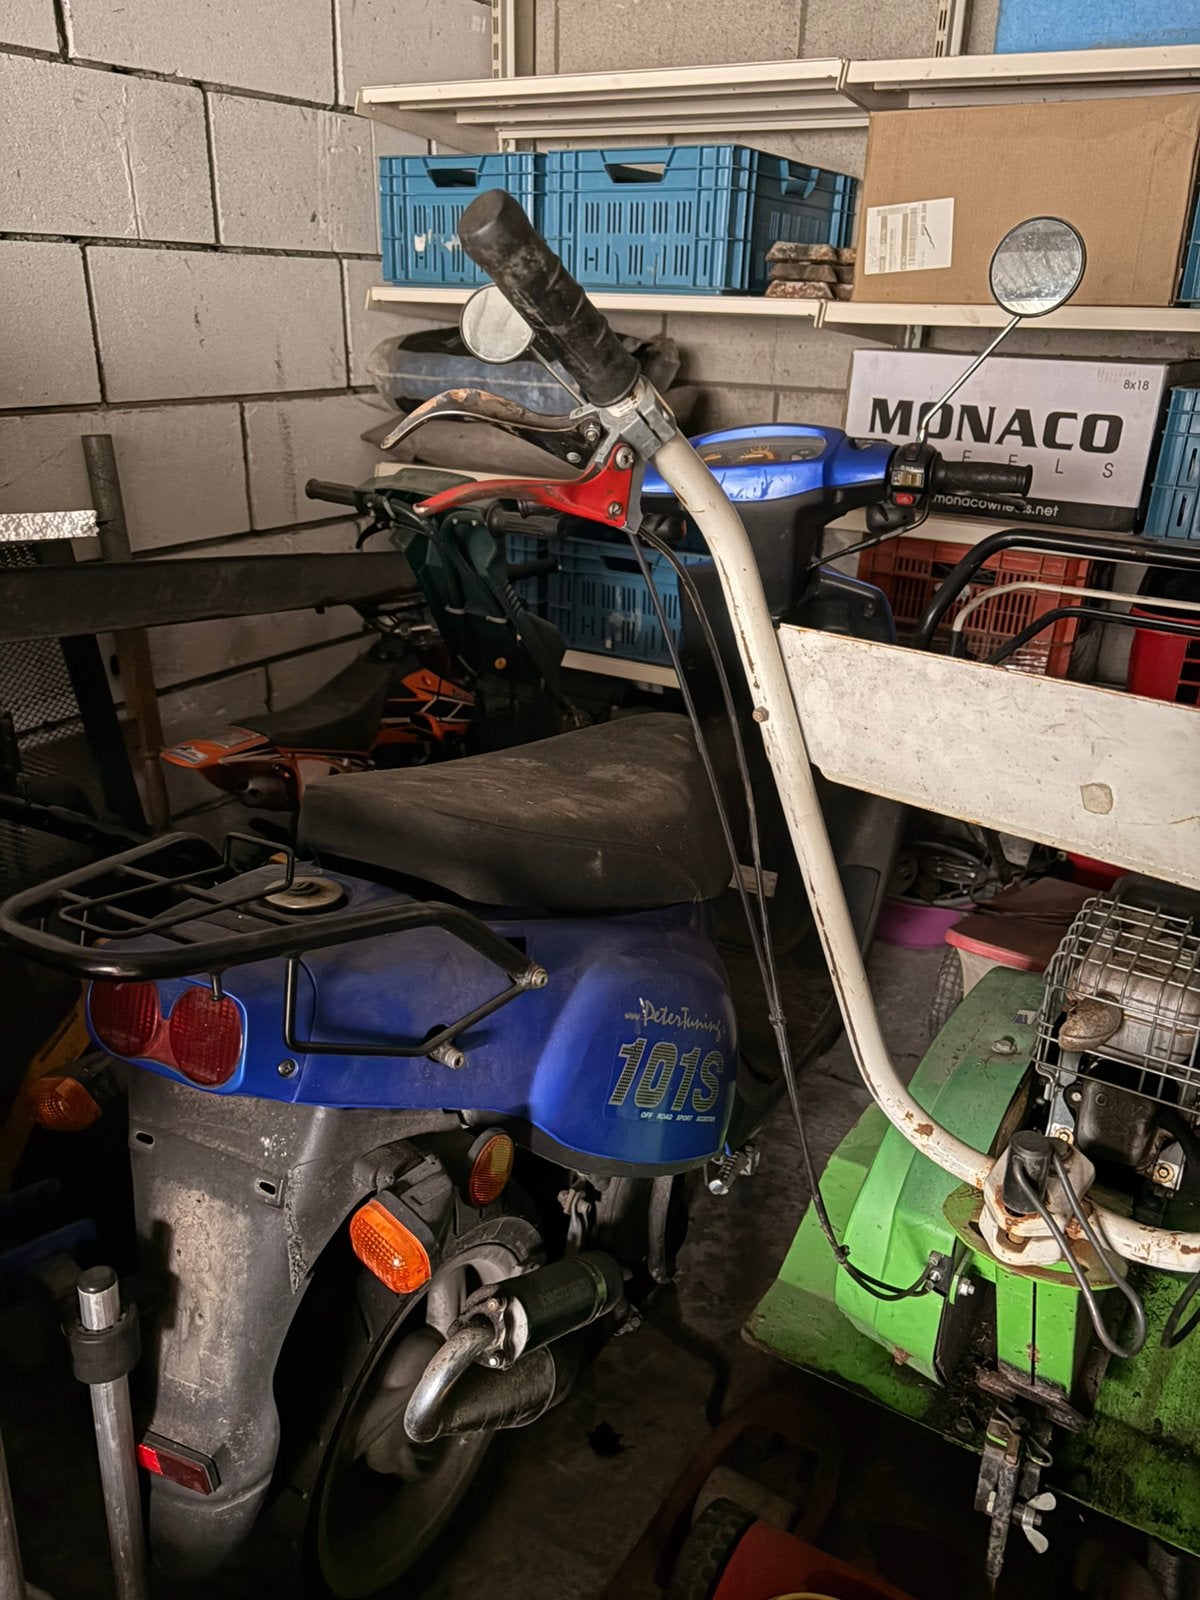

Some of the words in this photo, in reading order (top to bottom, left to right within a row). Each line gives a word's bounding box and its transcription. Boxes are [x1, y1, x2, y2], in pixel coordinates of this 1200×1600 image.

[1122, 379, 1150, 391] 8x18
[869, 397, 1124, 455] MONACO
[933, 494, 1060, 518] monacowes.net
[608, 1037, 725, 1113] 101S
[640, 1111, 653, 1119] OFF
[656, 1112, 673, 1120] ROAD
